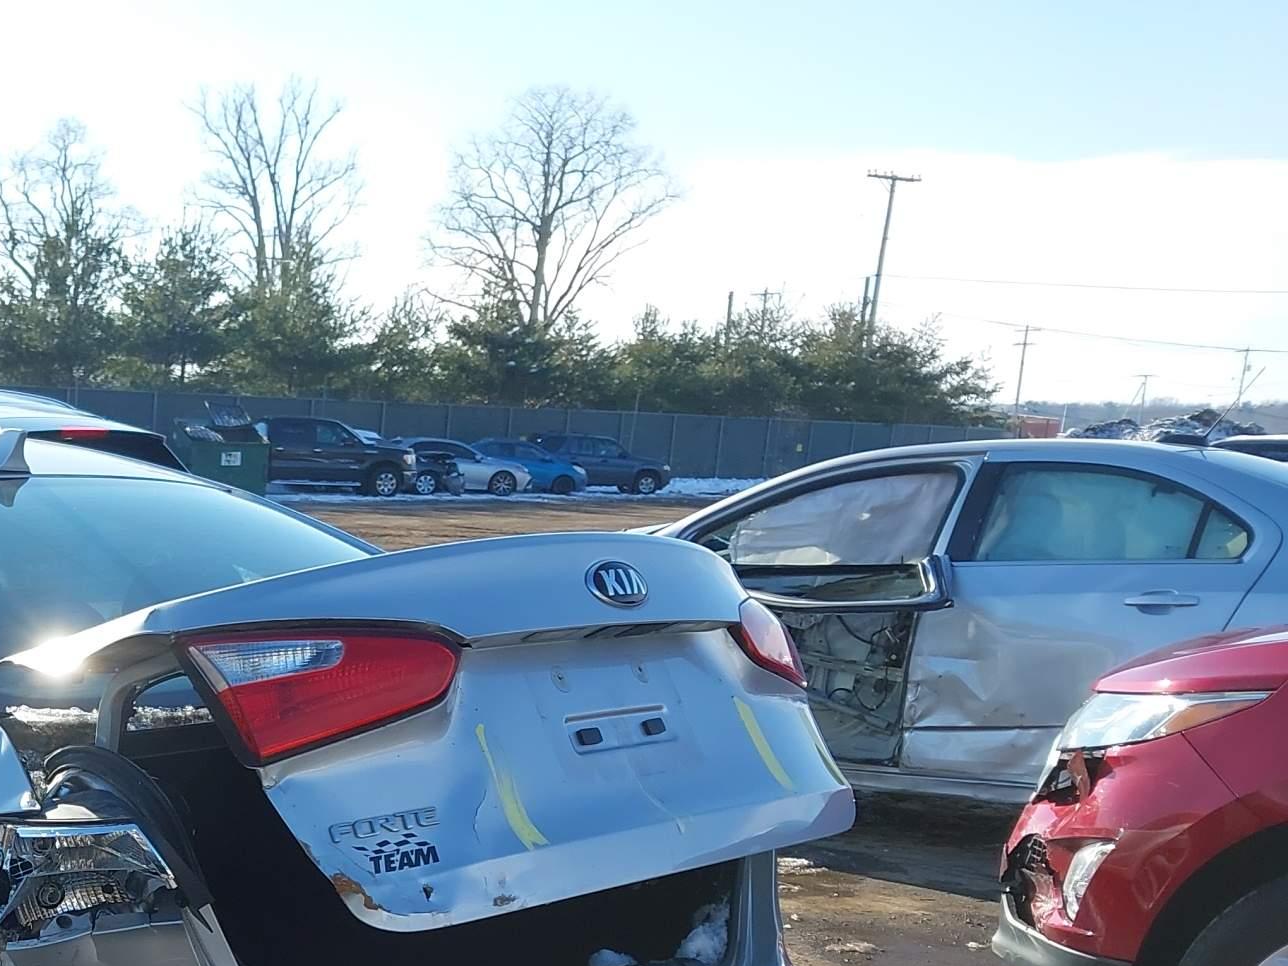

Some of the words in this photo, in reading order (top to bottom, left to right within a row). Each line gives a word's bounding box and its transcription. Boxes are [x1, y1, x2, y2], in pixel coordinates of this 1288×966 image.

[598, 568, 647, 596] KIA
[328, 807, 441, 844] FORTE
[368, 845, 440, 875] TEAM
